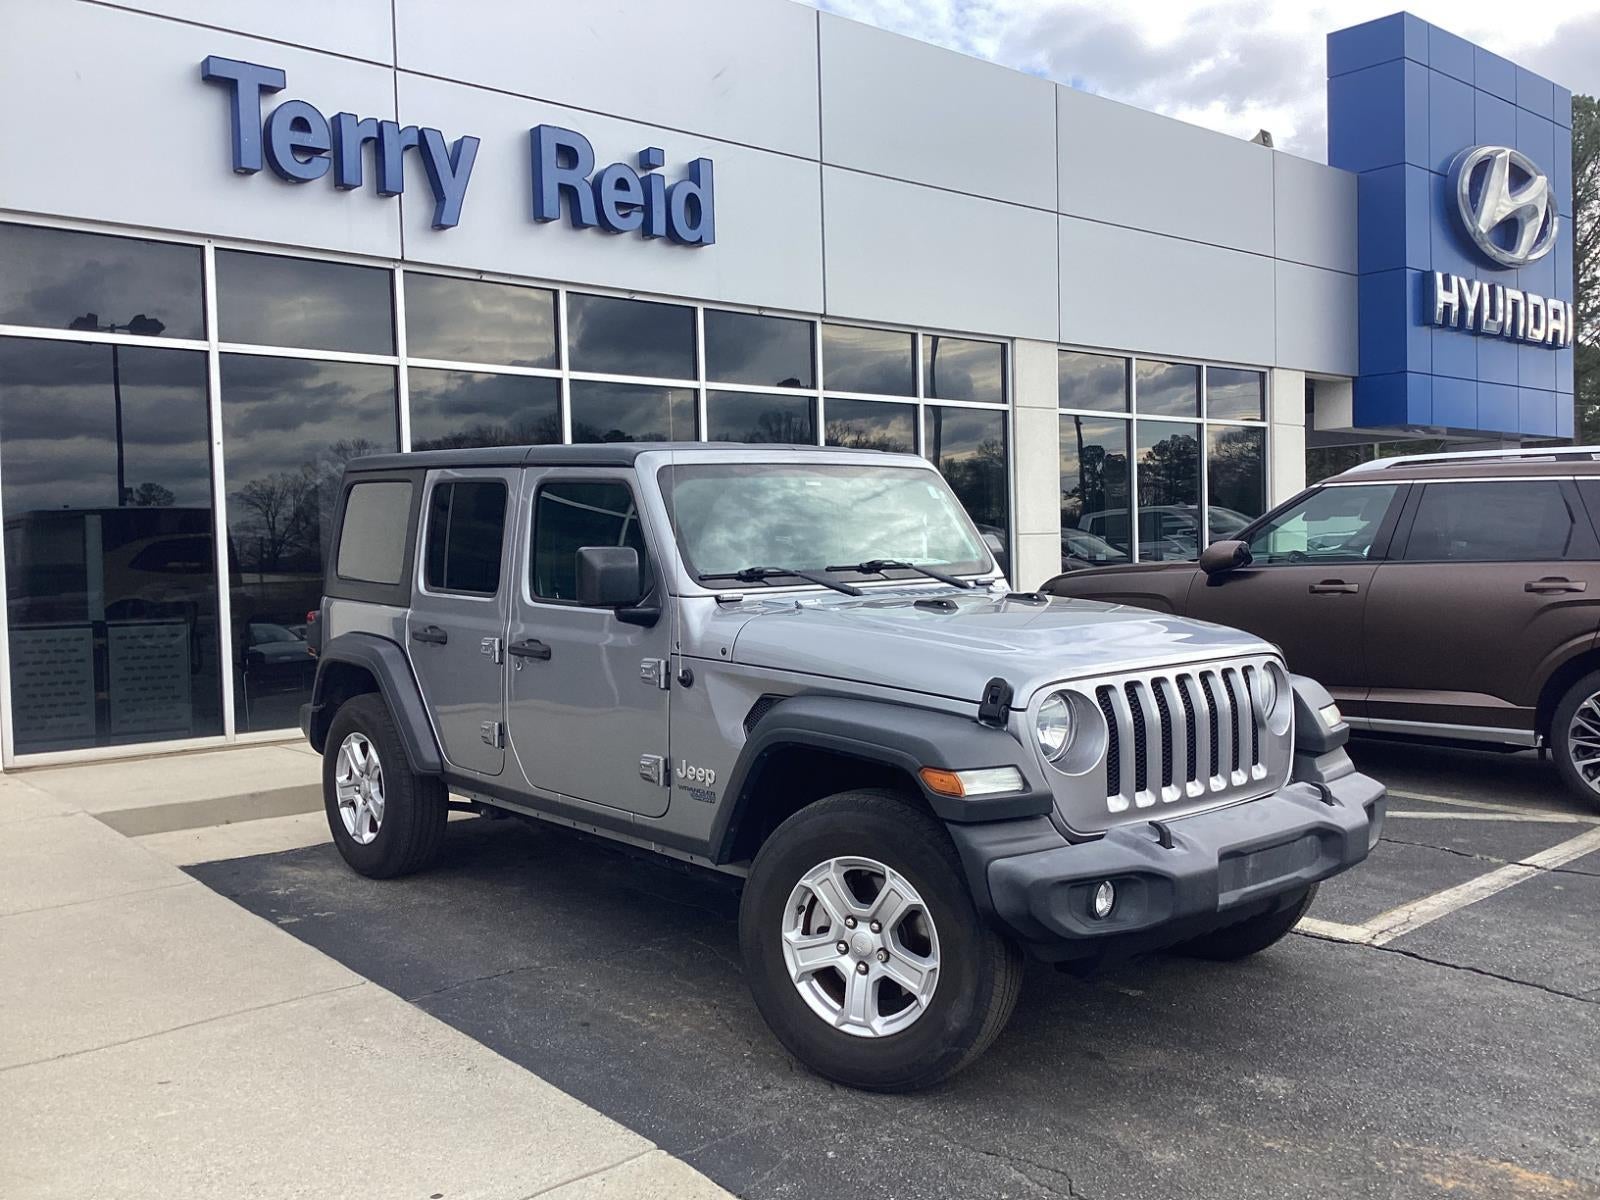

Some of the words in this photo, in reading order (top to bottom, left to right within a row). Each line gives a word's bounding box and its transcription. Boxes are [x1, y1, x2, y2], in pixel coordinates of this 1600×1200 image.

[201, 55, 480, 230] Terry
[530, 124, 715, 247] Reid
[1434, 271, 1574, 349] HYUNDAI
[676, 759, 716, 787] Jeep
